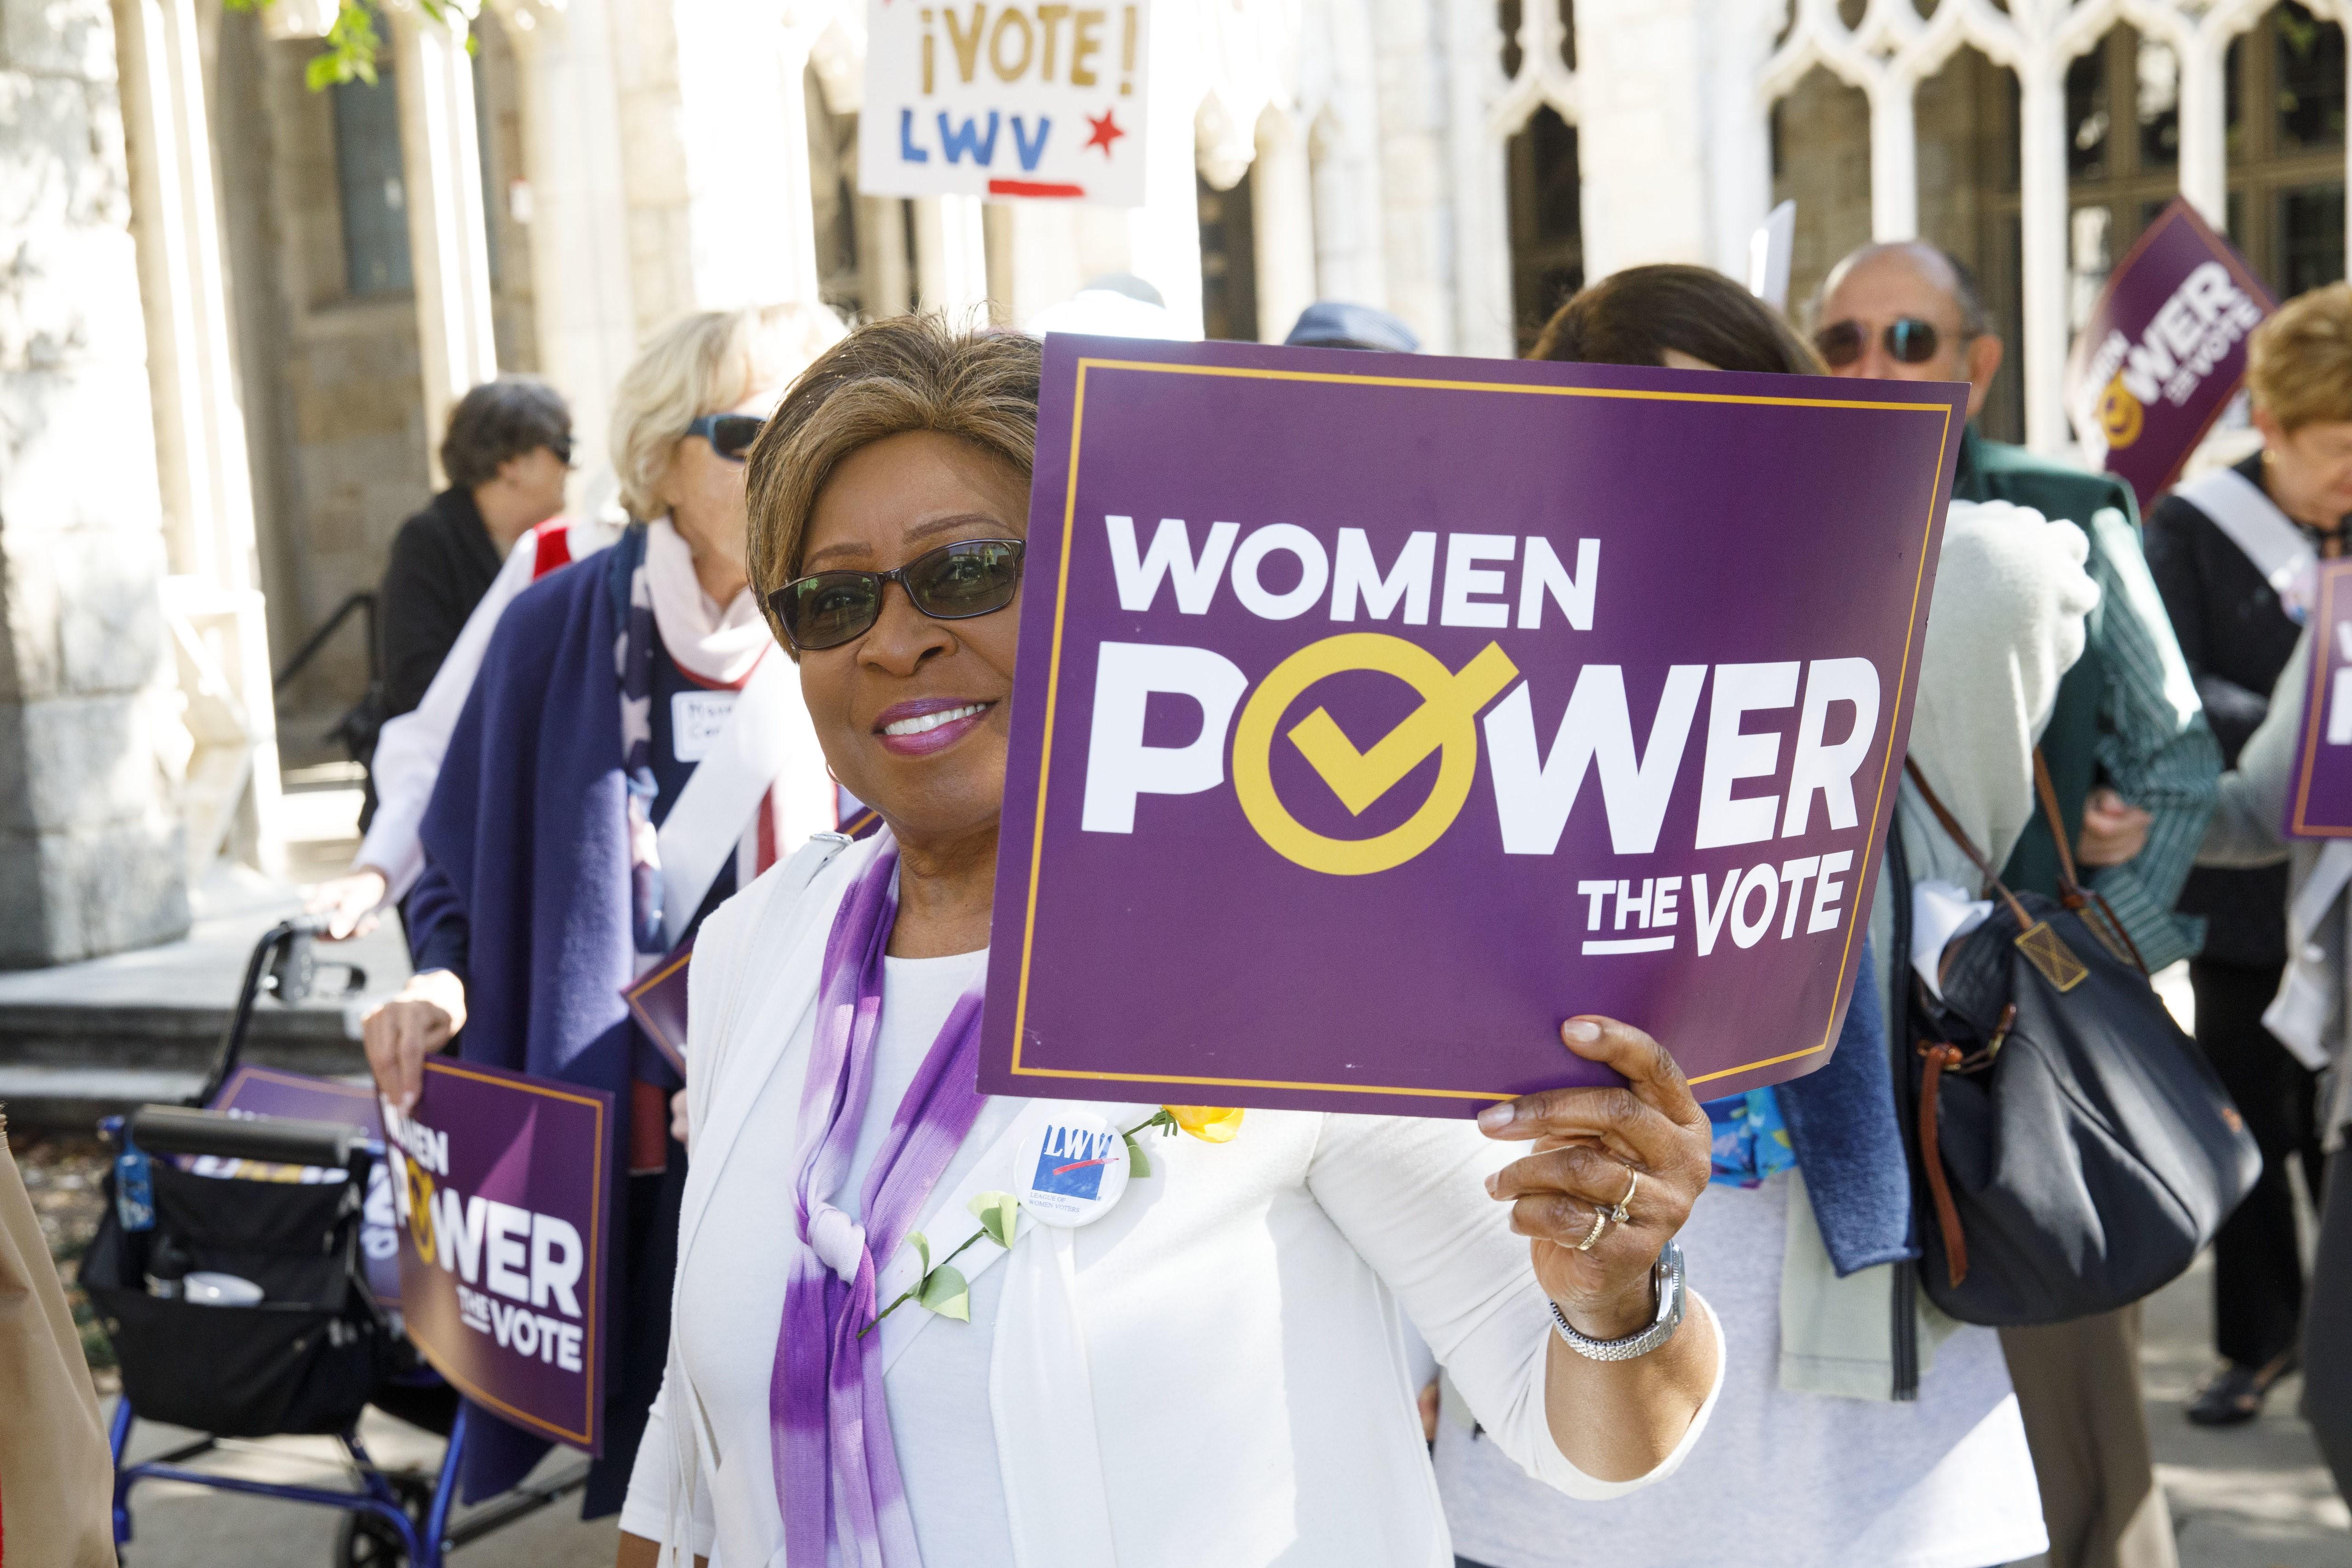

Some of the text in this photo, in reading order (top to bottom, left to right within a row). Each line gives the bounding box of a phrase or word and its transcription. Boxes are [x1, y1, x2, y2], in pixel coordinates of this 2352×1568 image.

[920, 2, 1138, 95] ¡VOTE!
[901, 108, 1051, 171] LWV
[1104, 514, 1601, 631] WOMEN
[1081, 632, 1881, 876] POWER
[1577, 849, 1854, 957] THE VOTE
[1044, 1125, 1112, 1160] LWV
[1029, 1200, 1080, 1213] WOMEN VOTERS
[1030, 1192, 1056, 1201] LEAGUE
[490, 1299, 583, 1373] VOTE
